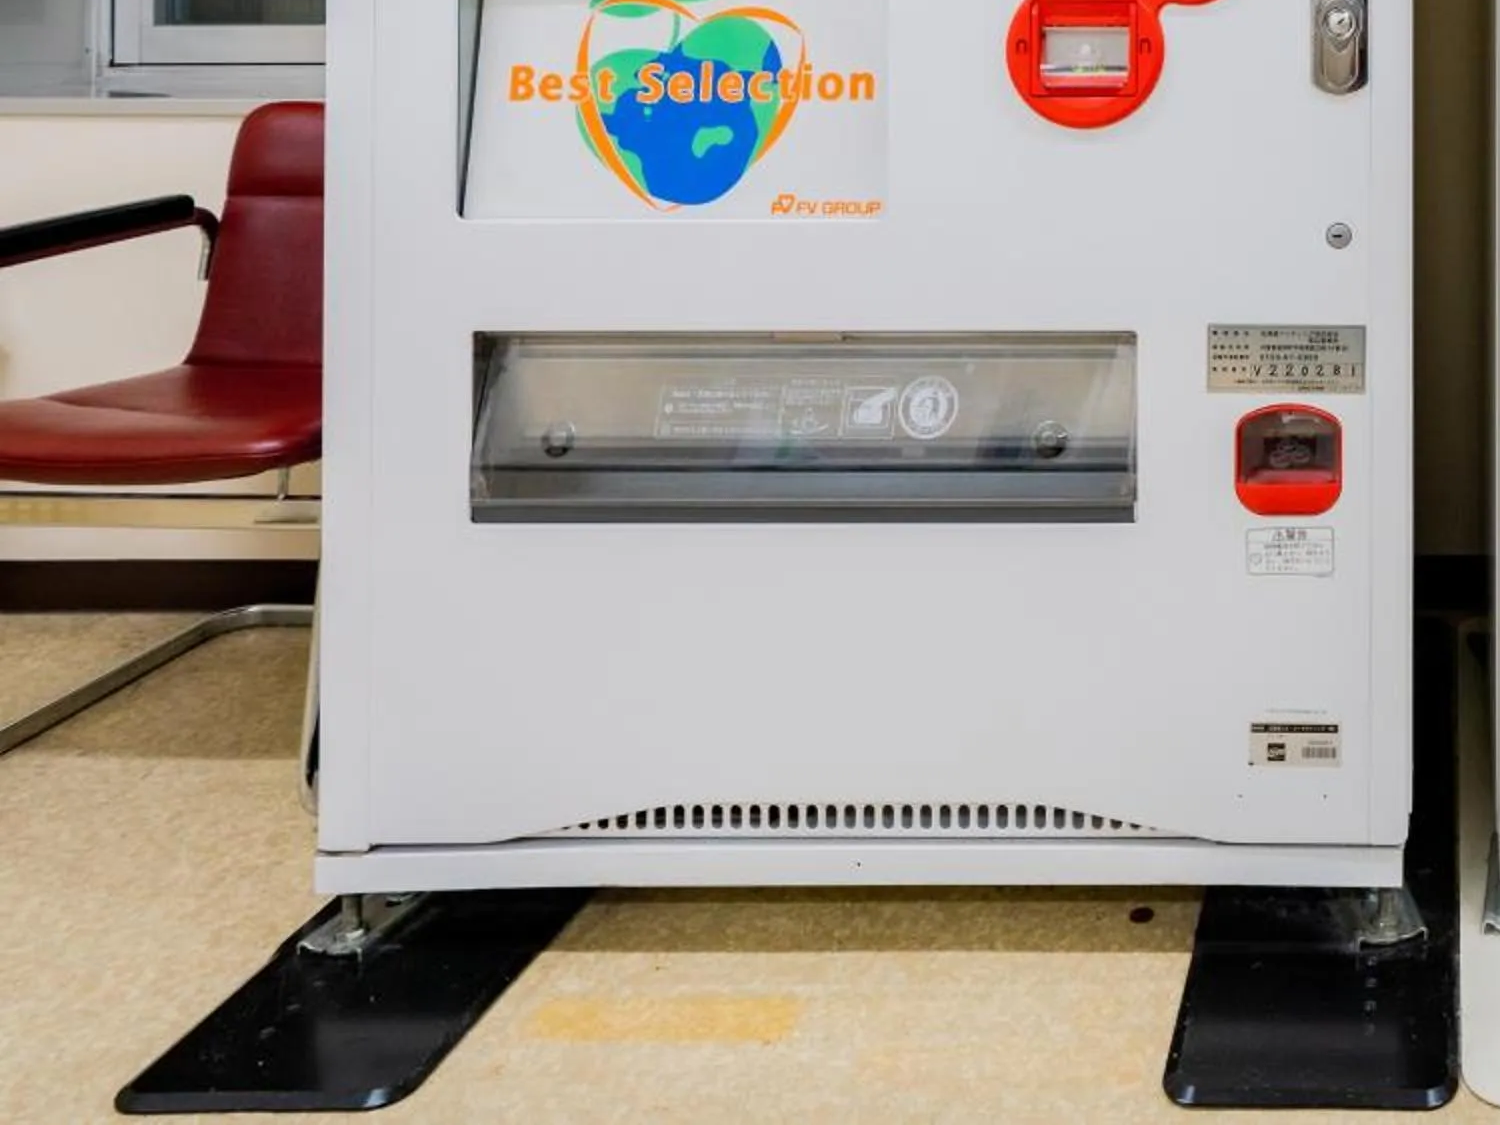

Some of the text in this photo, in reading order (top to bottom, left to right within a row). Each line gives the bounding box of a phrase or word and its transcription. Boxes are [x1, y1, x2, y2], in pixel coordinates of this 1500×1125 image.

[508, 61, 877, 105] Best Selection
[822, 200, 883, 216] GROUP
